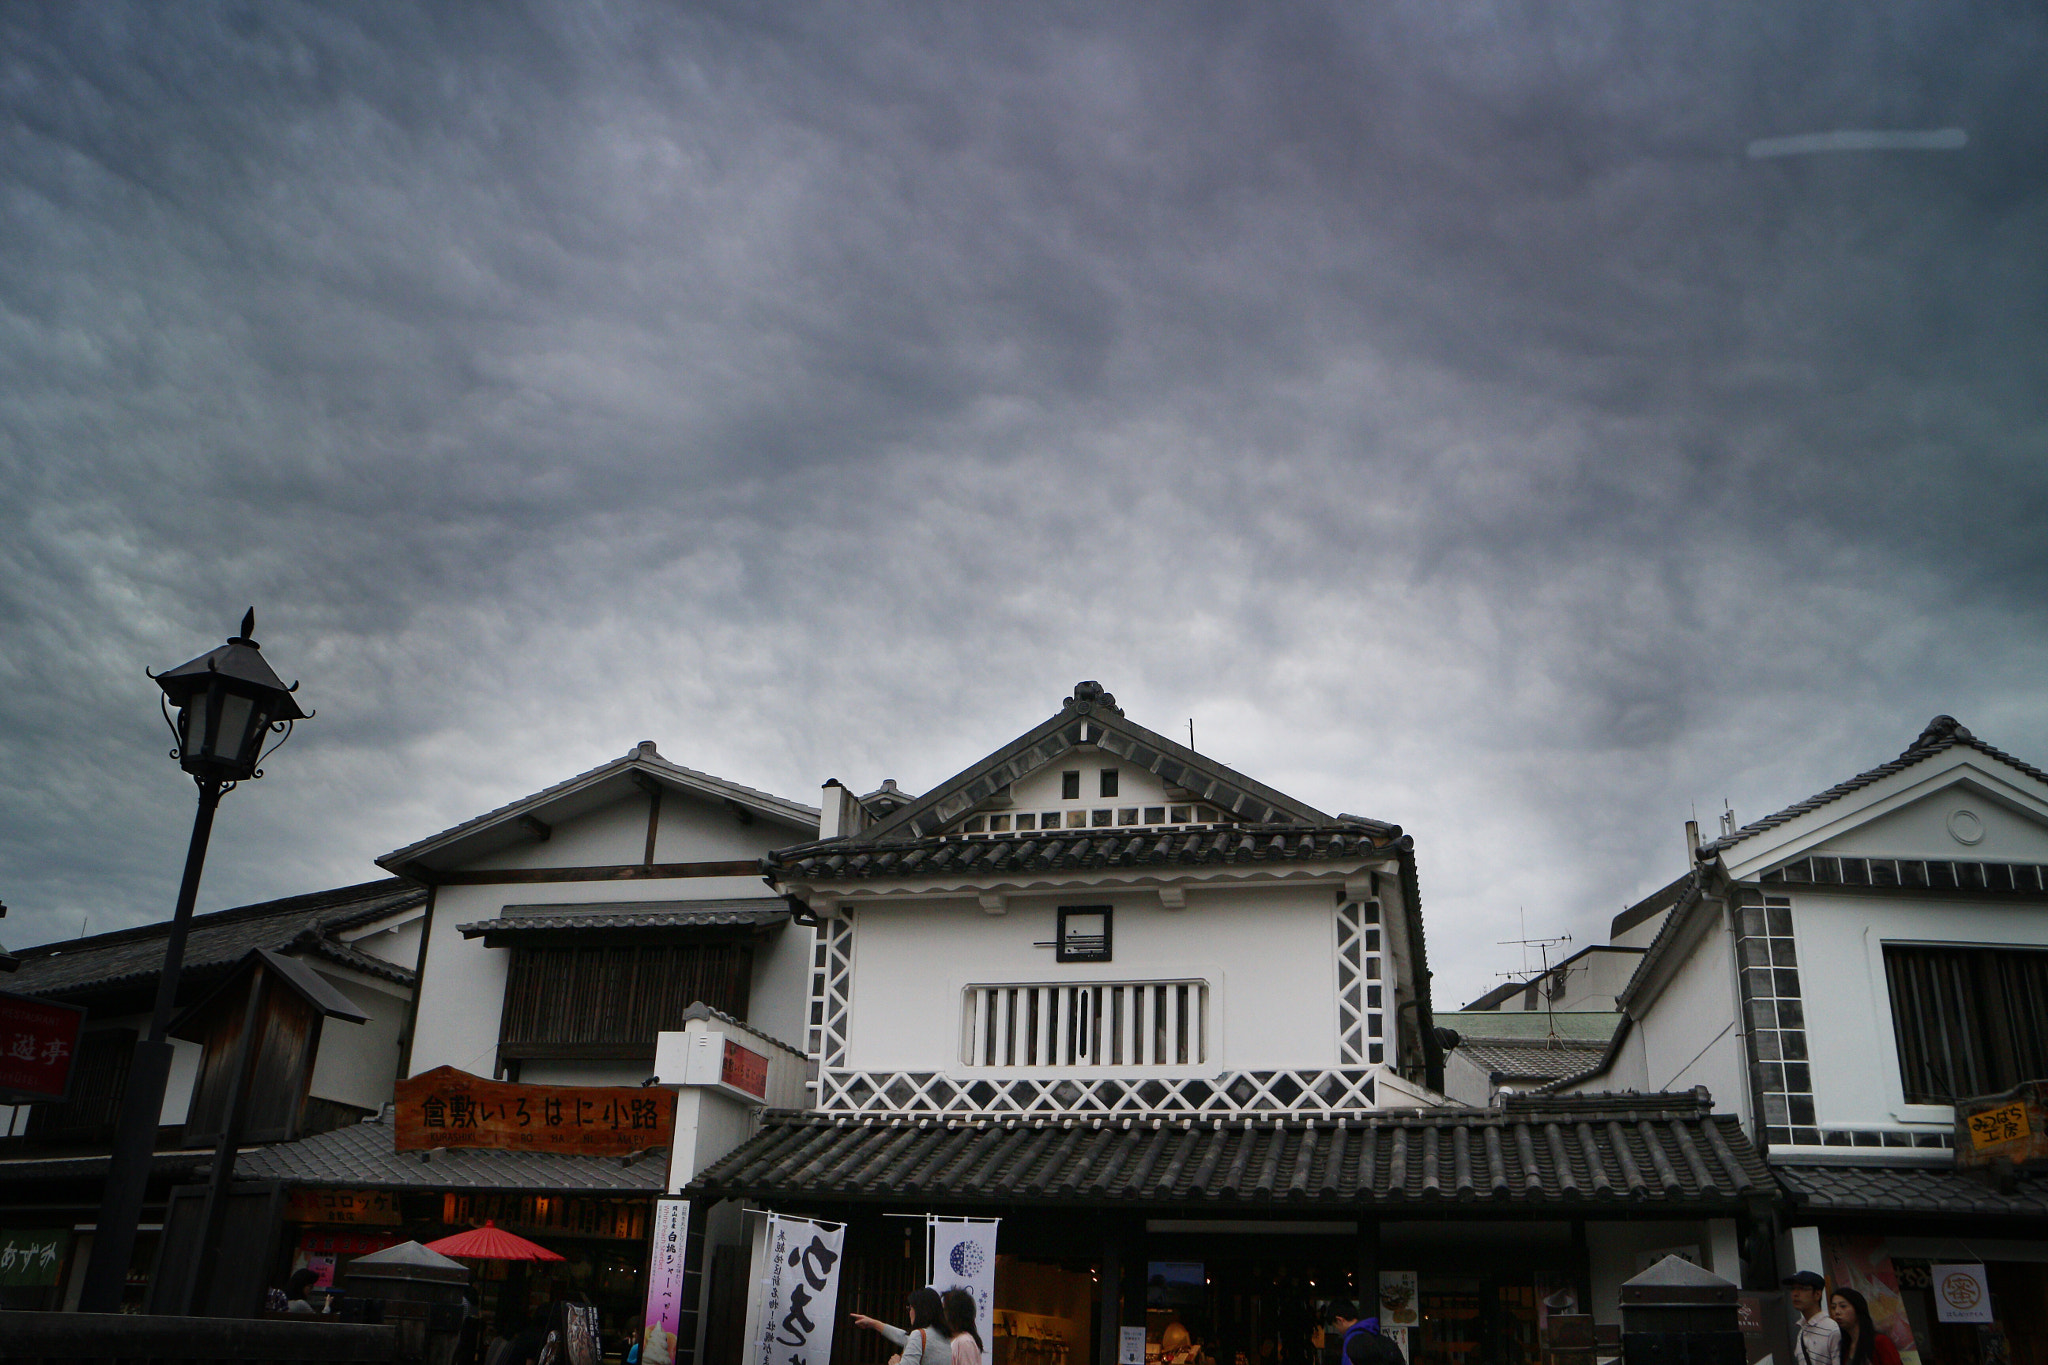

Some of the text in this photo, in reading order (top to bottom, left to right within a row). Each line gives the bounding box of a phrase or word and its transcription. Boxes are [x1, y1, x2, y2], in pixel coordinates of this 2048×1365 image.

[0, 1033, 70, 1066] 遊亭
[421, 1095, 658, 1130] 倉敷いろはに小路
[430, 1132, 477, 1143] KURASHIKI
[520, 1134, 534, 1143] RO
[583, 1134, 594, 1144] NI
[616, 1134, 646, 1146] ALLEY
[1983, 1122, 2019, 1143] 工房
[662, 1205, 670, 1223] White
[658, 1245, 666, 1270] Sherbet
